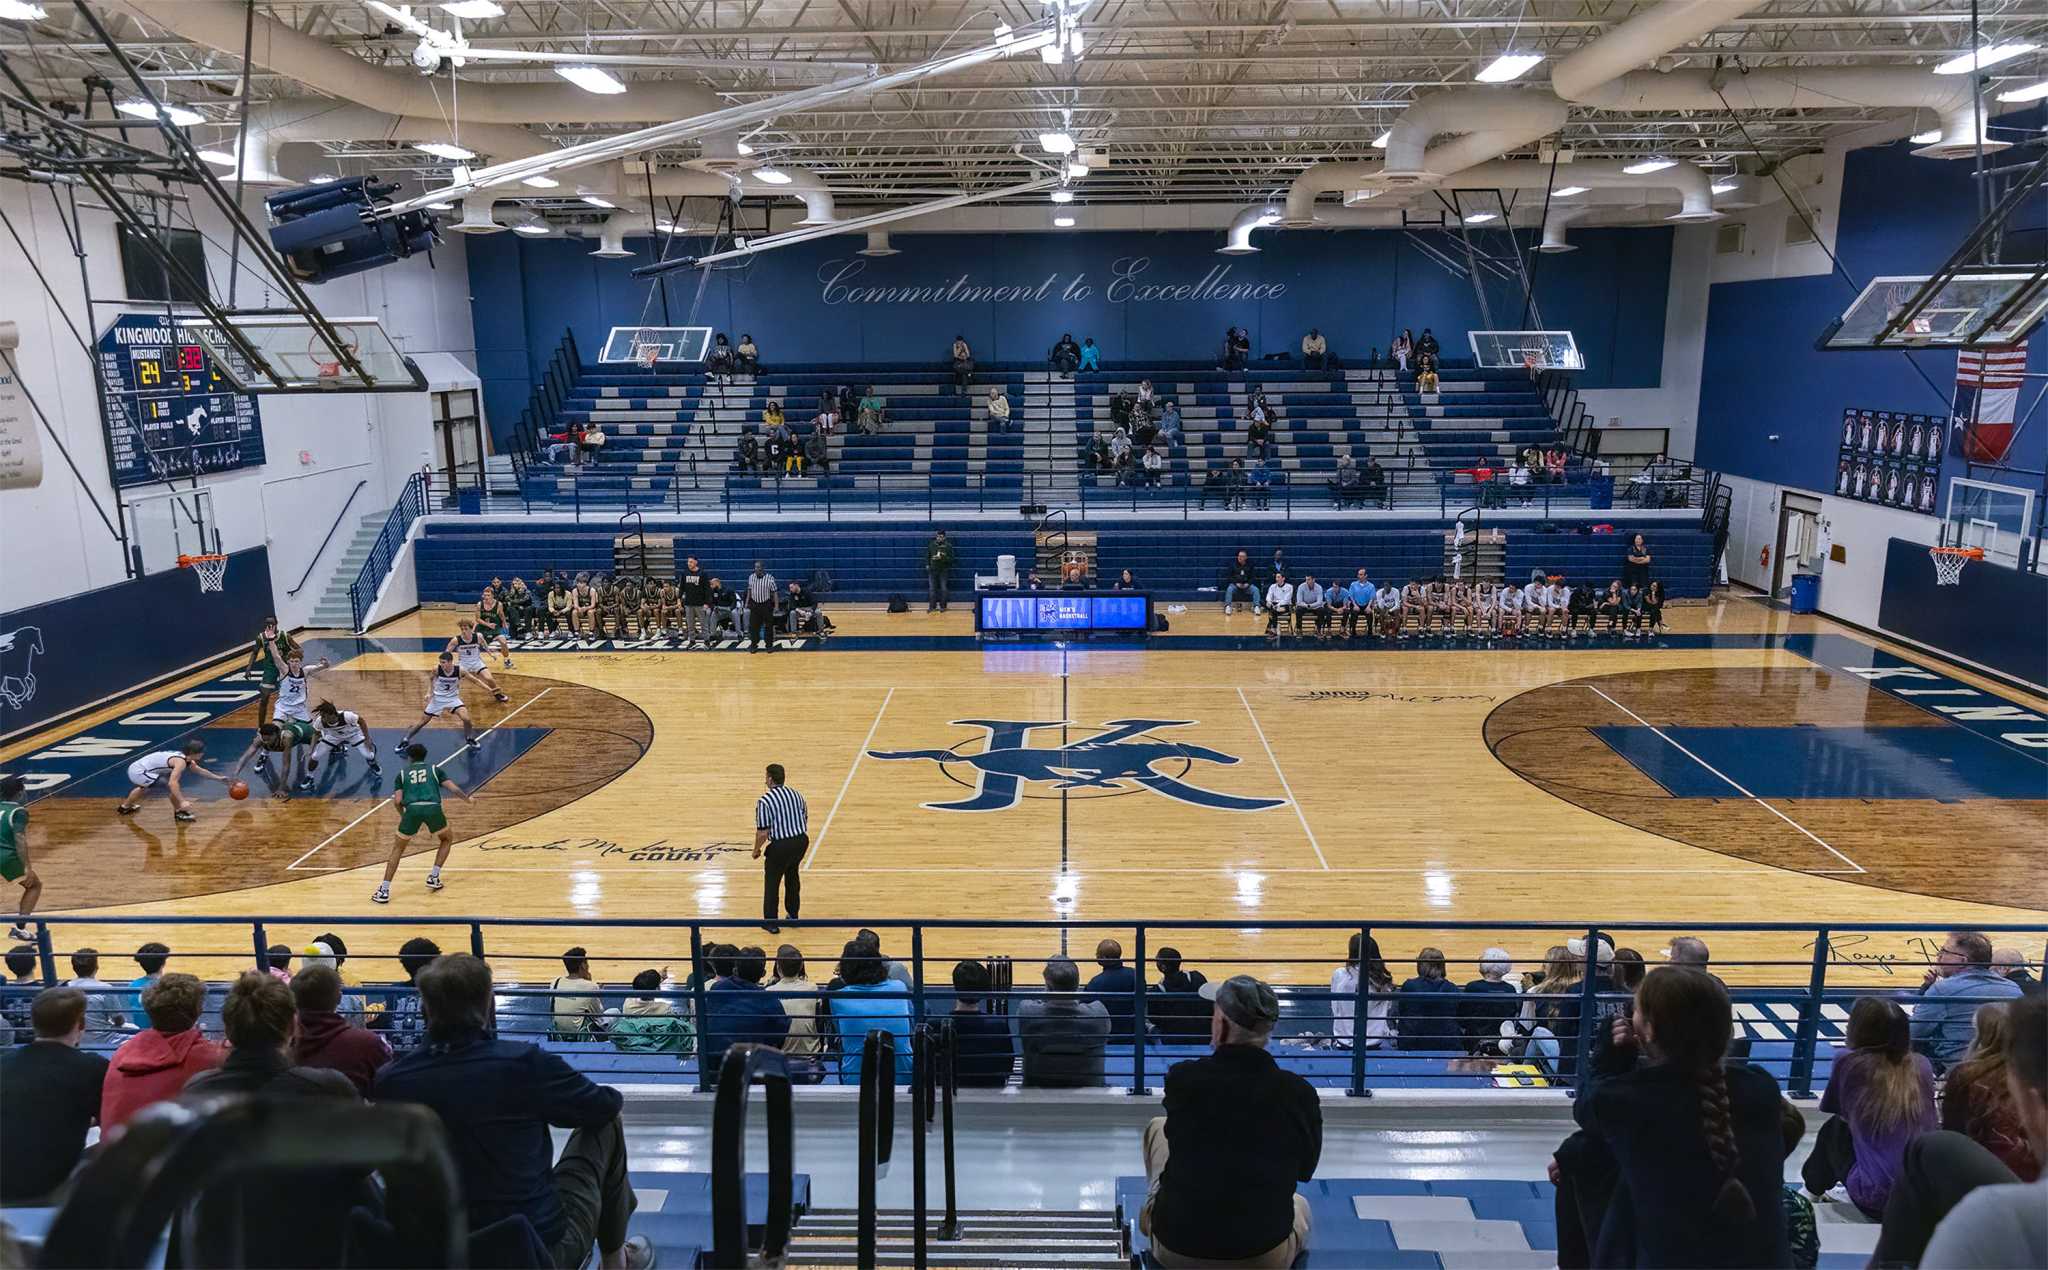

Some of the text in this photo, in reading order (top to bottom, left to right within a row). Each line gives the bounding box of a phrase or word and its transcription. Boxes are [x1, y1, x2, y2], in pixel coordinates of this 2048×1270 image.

[816, 256, 1287, 304] Commitment to Excellence
[176, 328, 196, 344] HIG
[203, 328, 231, 345] SCHO
[140, 361, 161, 384] 24
[151, 402, 158, 418] 1
[408, 768, 427, 784] 32
[629, 852, 720, 861] COURT
